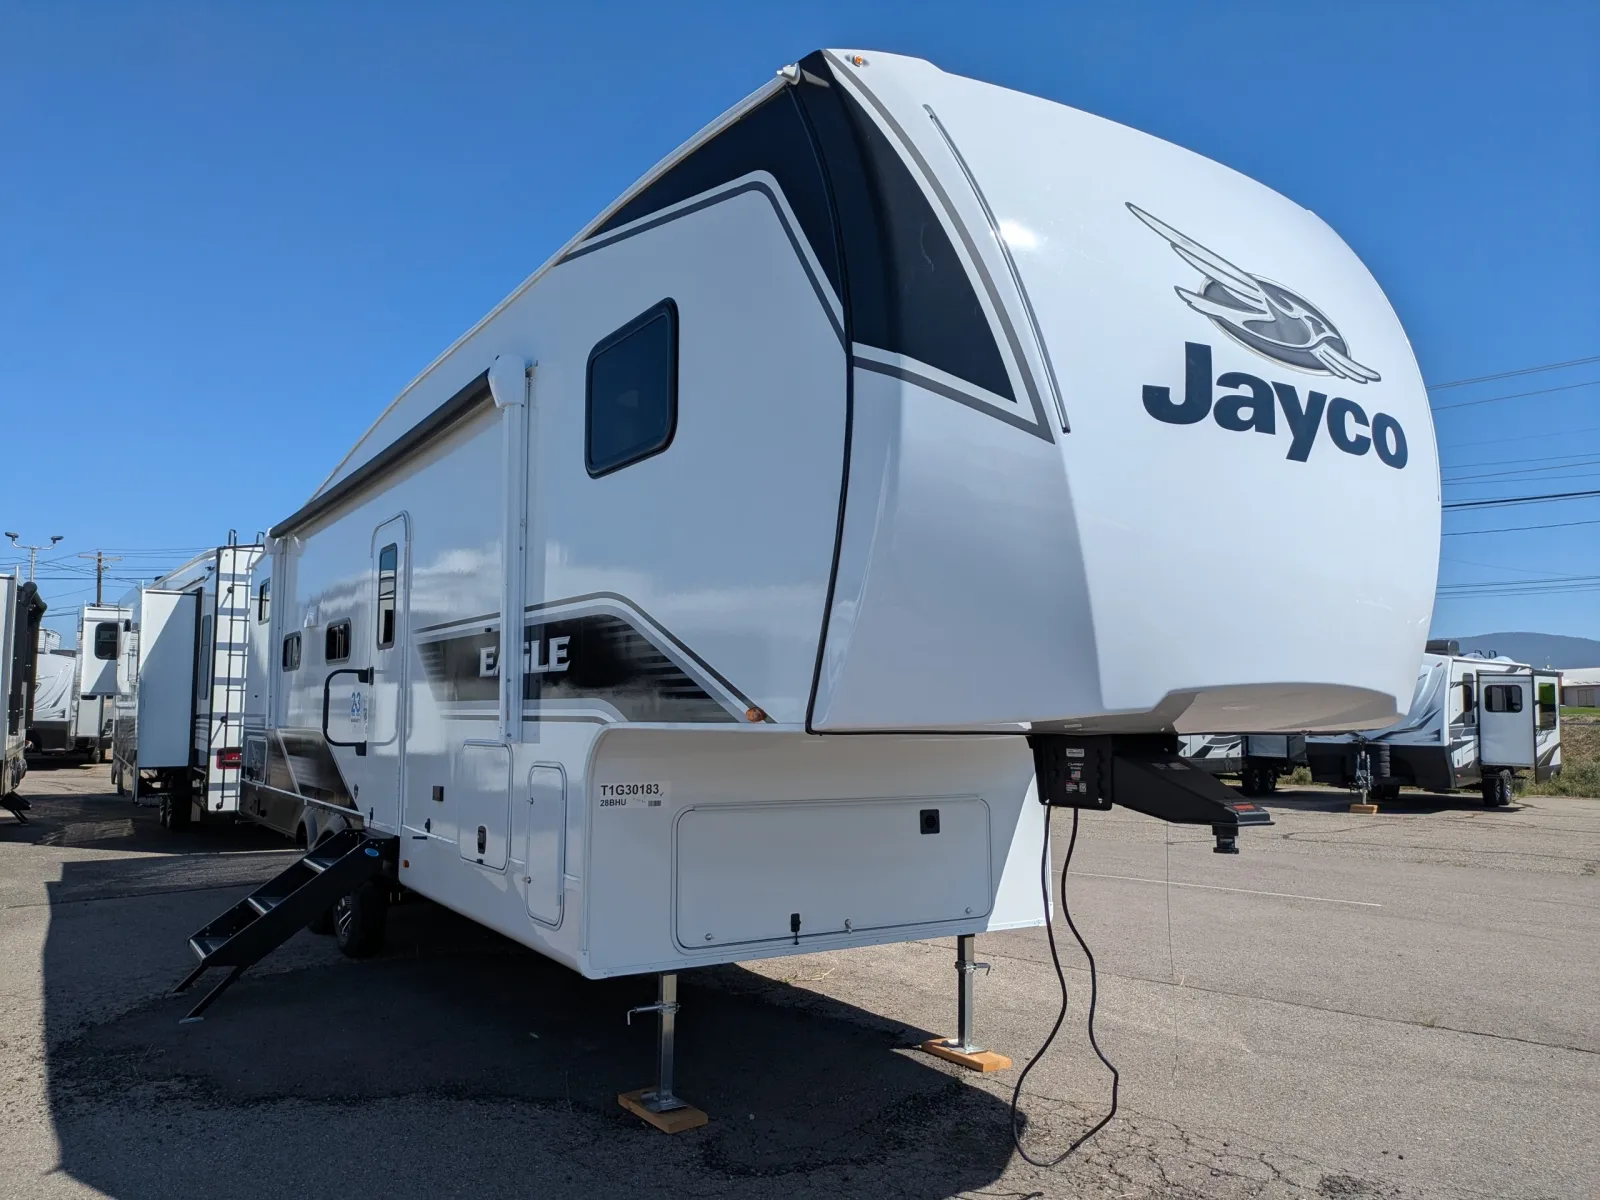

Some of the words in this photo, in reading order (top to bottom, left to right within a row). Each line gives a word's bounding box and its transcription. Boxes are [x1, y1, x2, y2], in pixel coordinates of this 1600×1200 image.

[1142, 341, 1409, 470] Jayco
[479, 635, 571, 678] ELE
[600, 783, 660, 796] T1G30183
[600, 798, 627, 807] 28BHU
